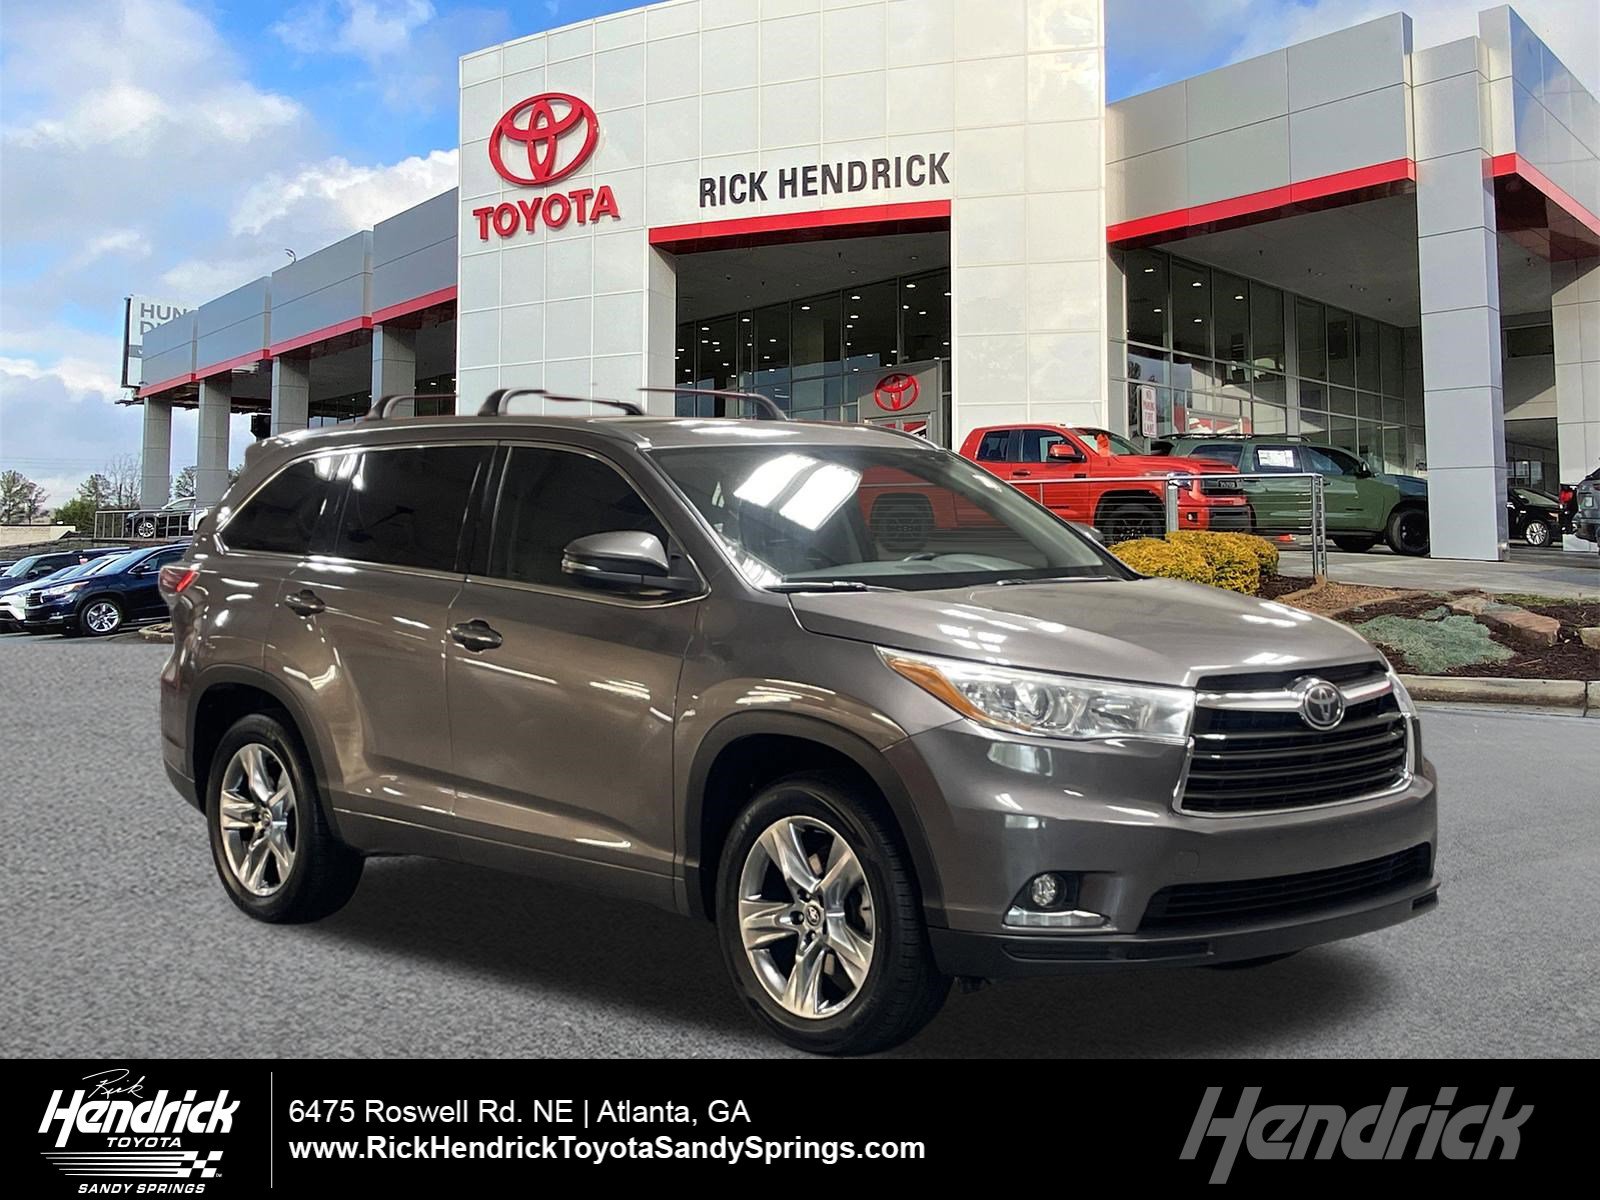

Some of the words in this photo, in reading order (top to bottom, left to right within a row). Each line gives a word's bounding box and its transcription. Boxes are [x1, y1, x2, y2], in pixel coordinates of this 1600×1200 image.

[699, 171, 768, 208] RICK
[778, 152, 950, 200] HENDRICK
[473, 185, 620, 240] TOYOTA
